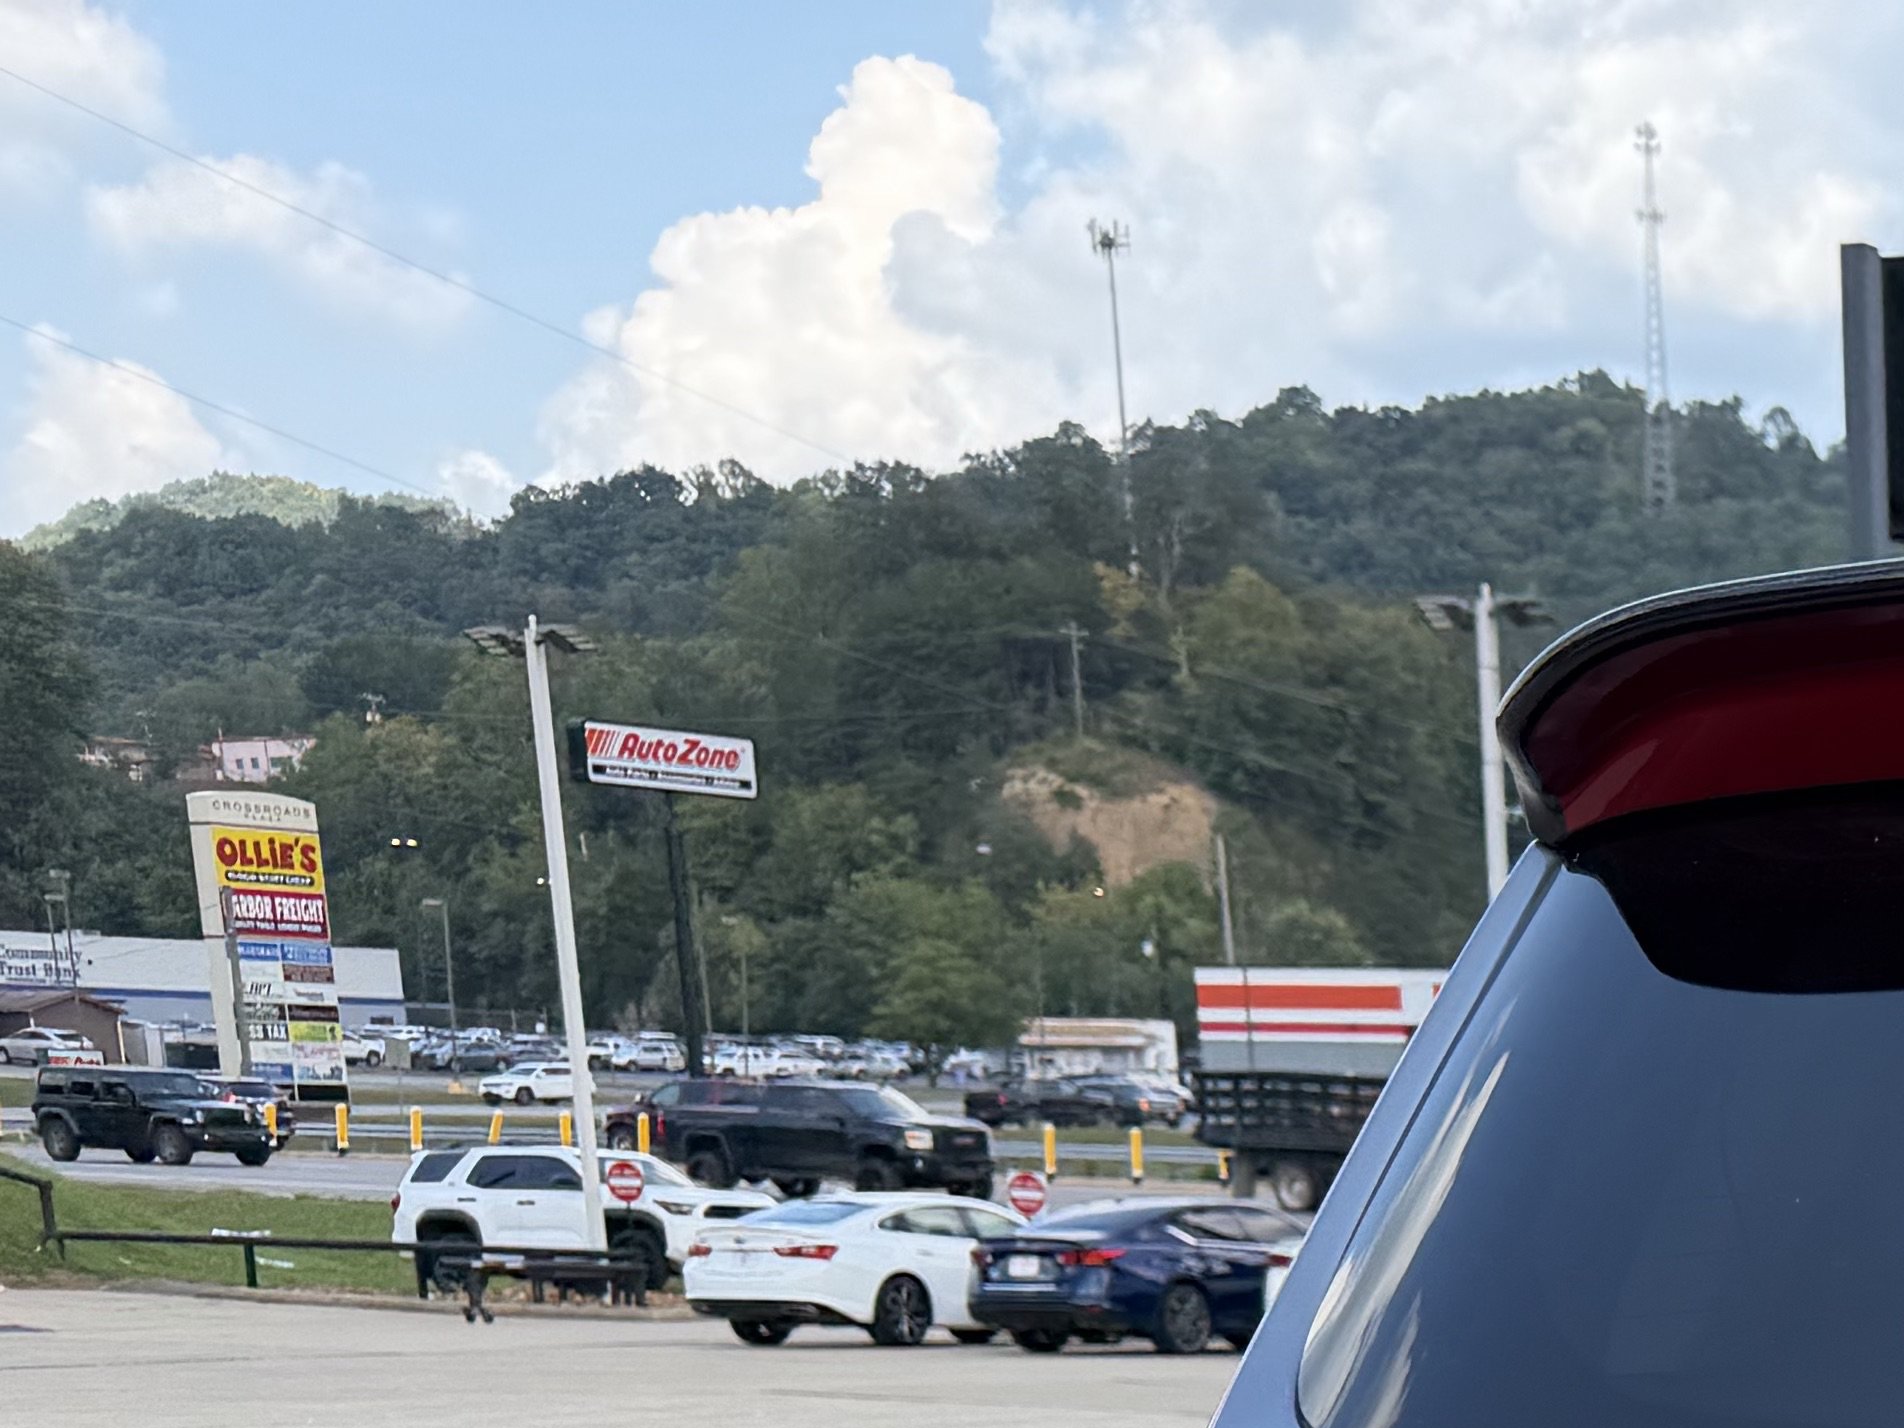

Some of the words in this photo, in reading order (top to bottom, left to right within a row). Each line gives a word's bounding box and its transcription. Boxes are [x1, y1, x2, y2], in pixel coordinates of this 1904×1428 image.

[617, 732, 741, 771] AutoZone
[212, 799, 311, 819] CROSSROADS
[231, 893, 274, 919] ARBOR
[274, 896, 324, 923] FREIGHT
